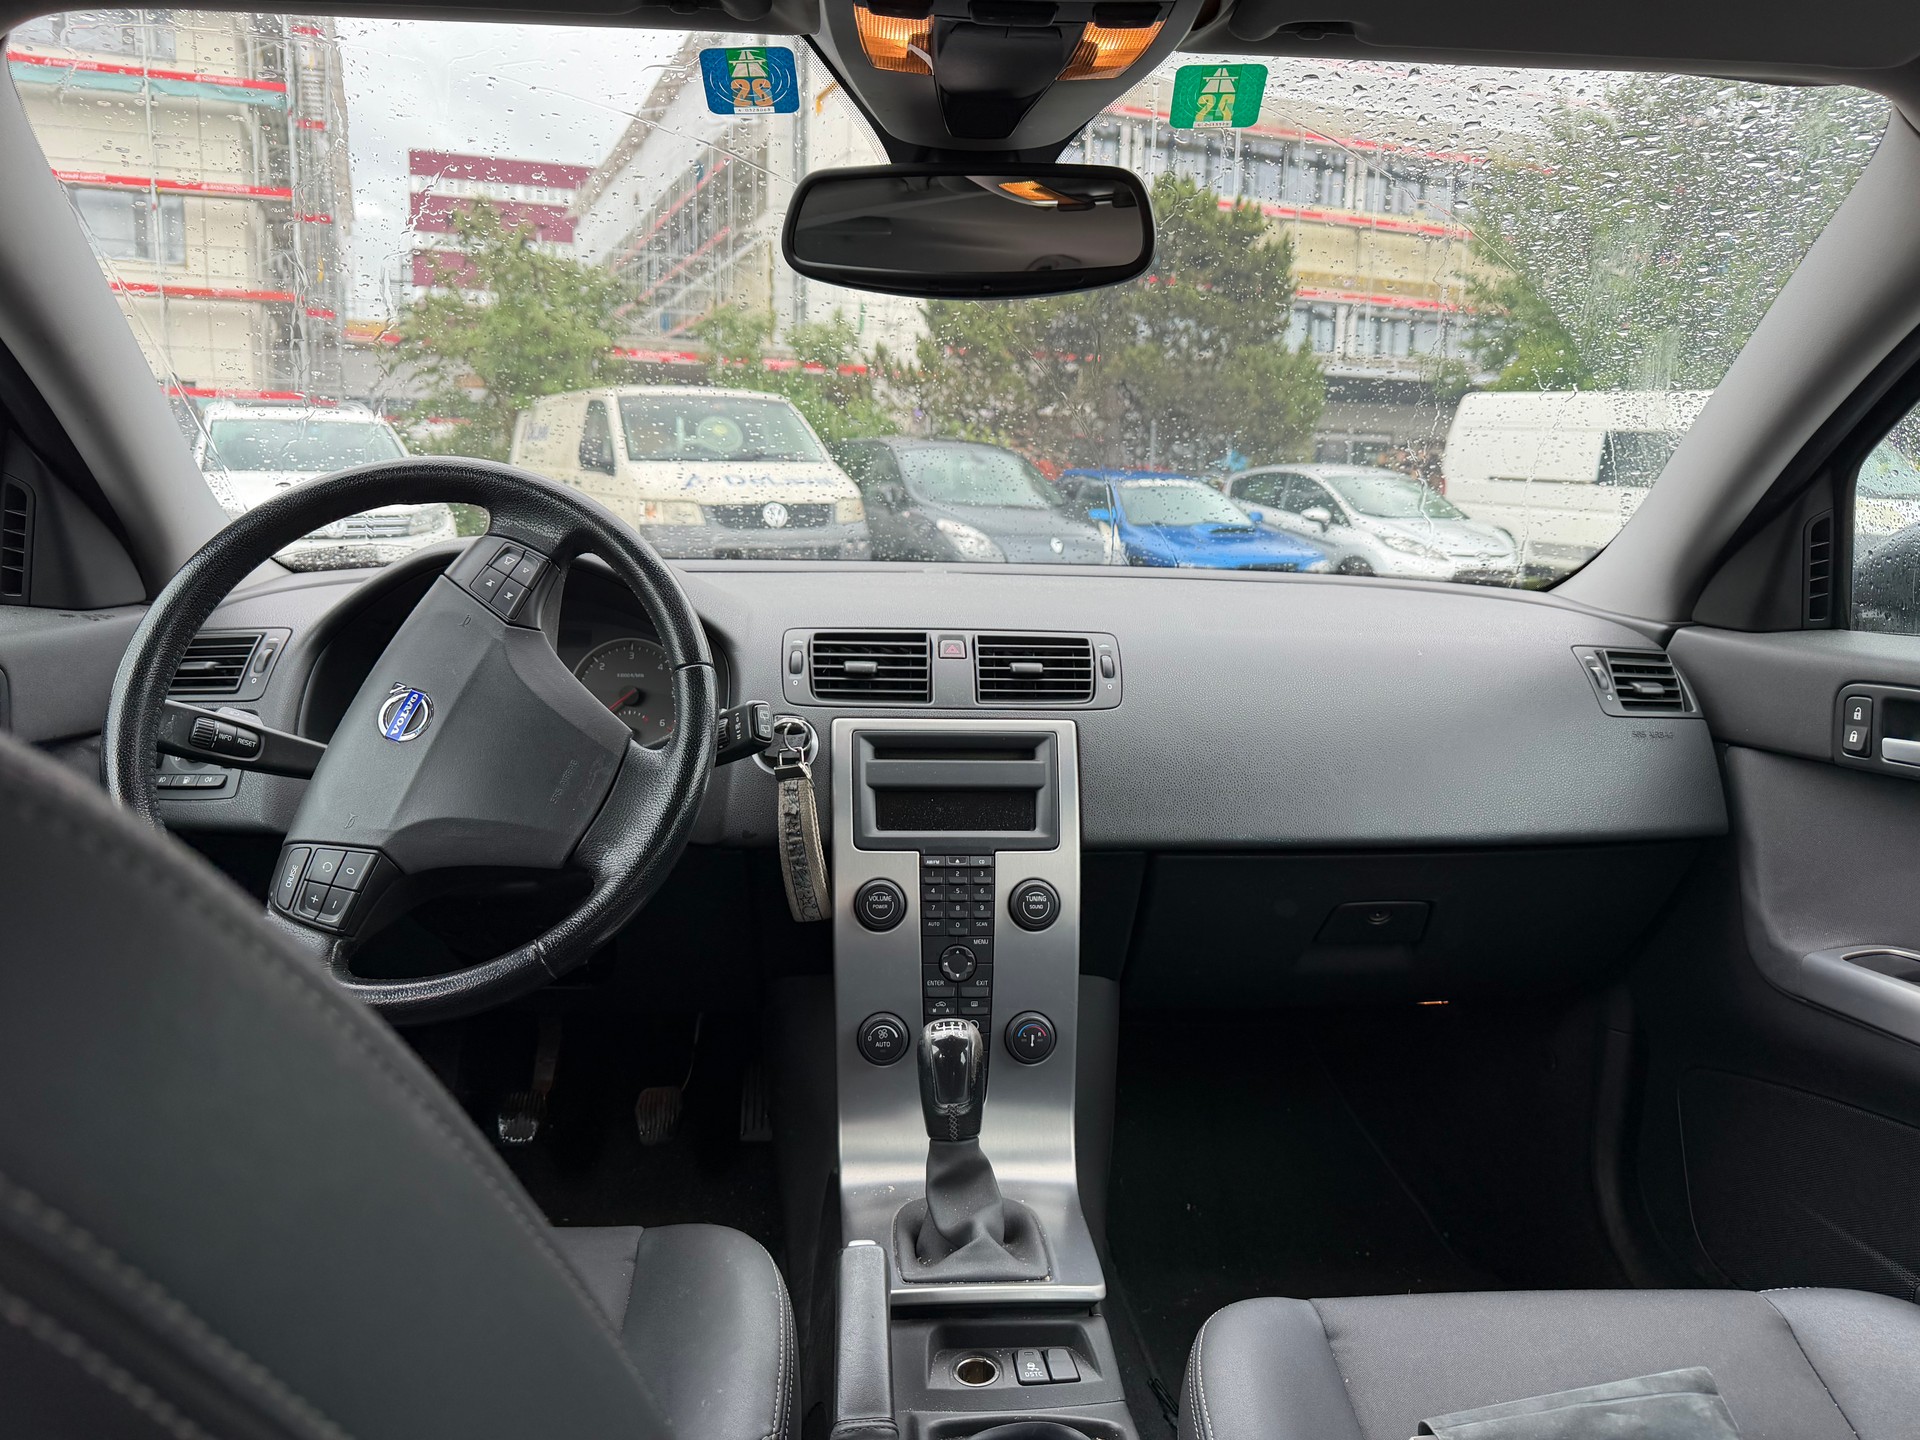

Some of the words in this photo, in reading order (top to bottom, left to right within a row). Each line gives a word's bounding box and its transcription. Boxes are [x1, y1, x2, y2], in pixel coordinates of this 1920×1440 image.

[629, 651, 635, 660] 3
[599, 662, 606, 671] 2
[657, 663, 664, 671] 4
[390, 693, 419, 736] VOLVO
[659, 719, 666, 727] 6
[219, 733, 233, 742] INFO
[237, 737, 257, 748] RESET
[285, 864, 299, 888] CRUISE
